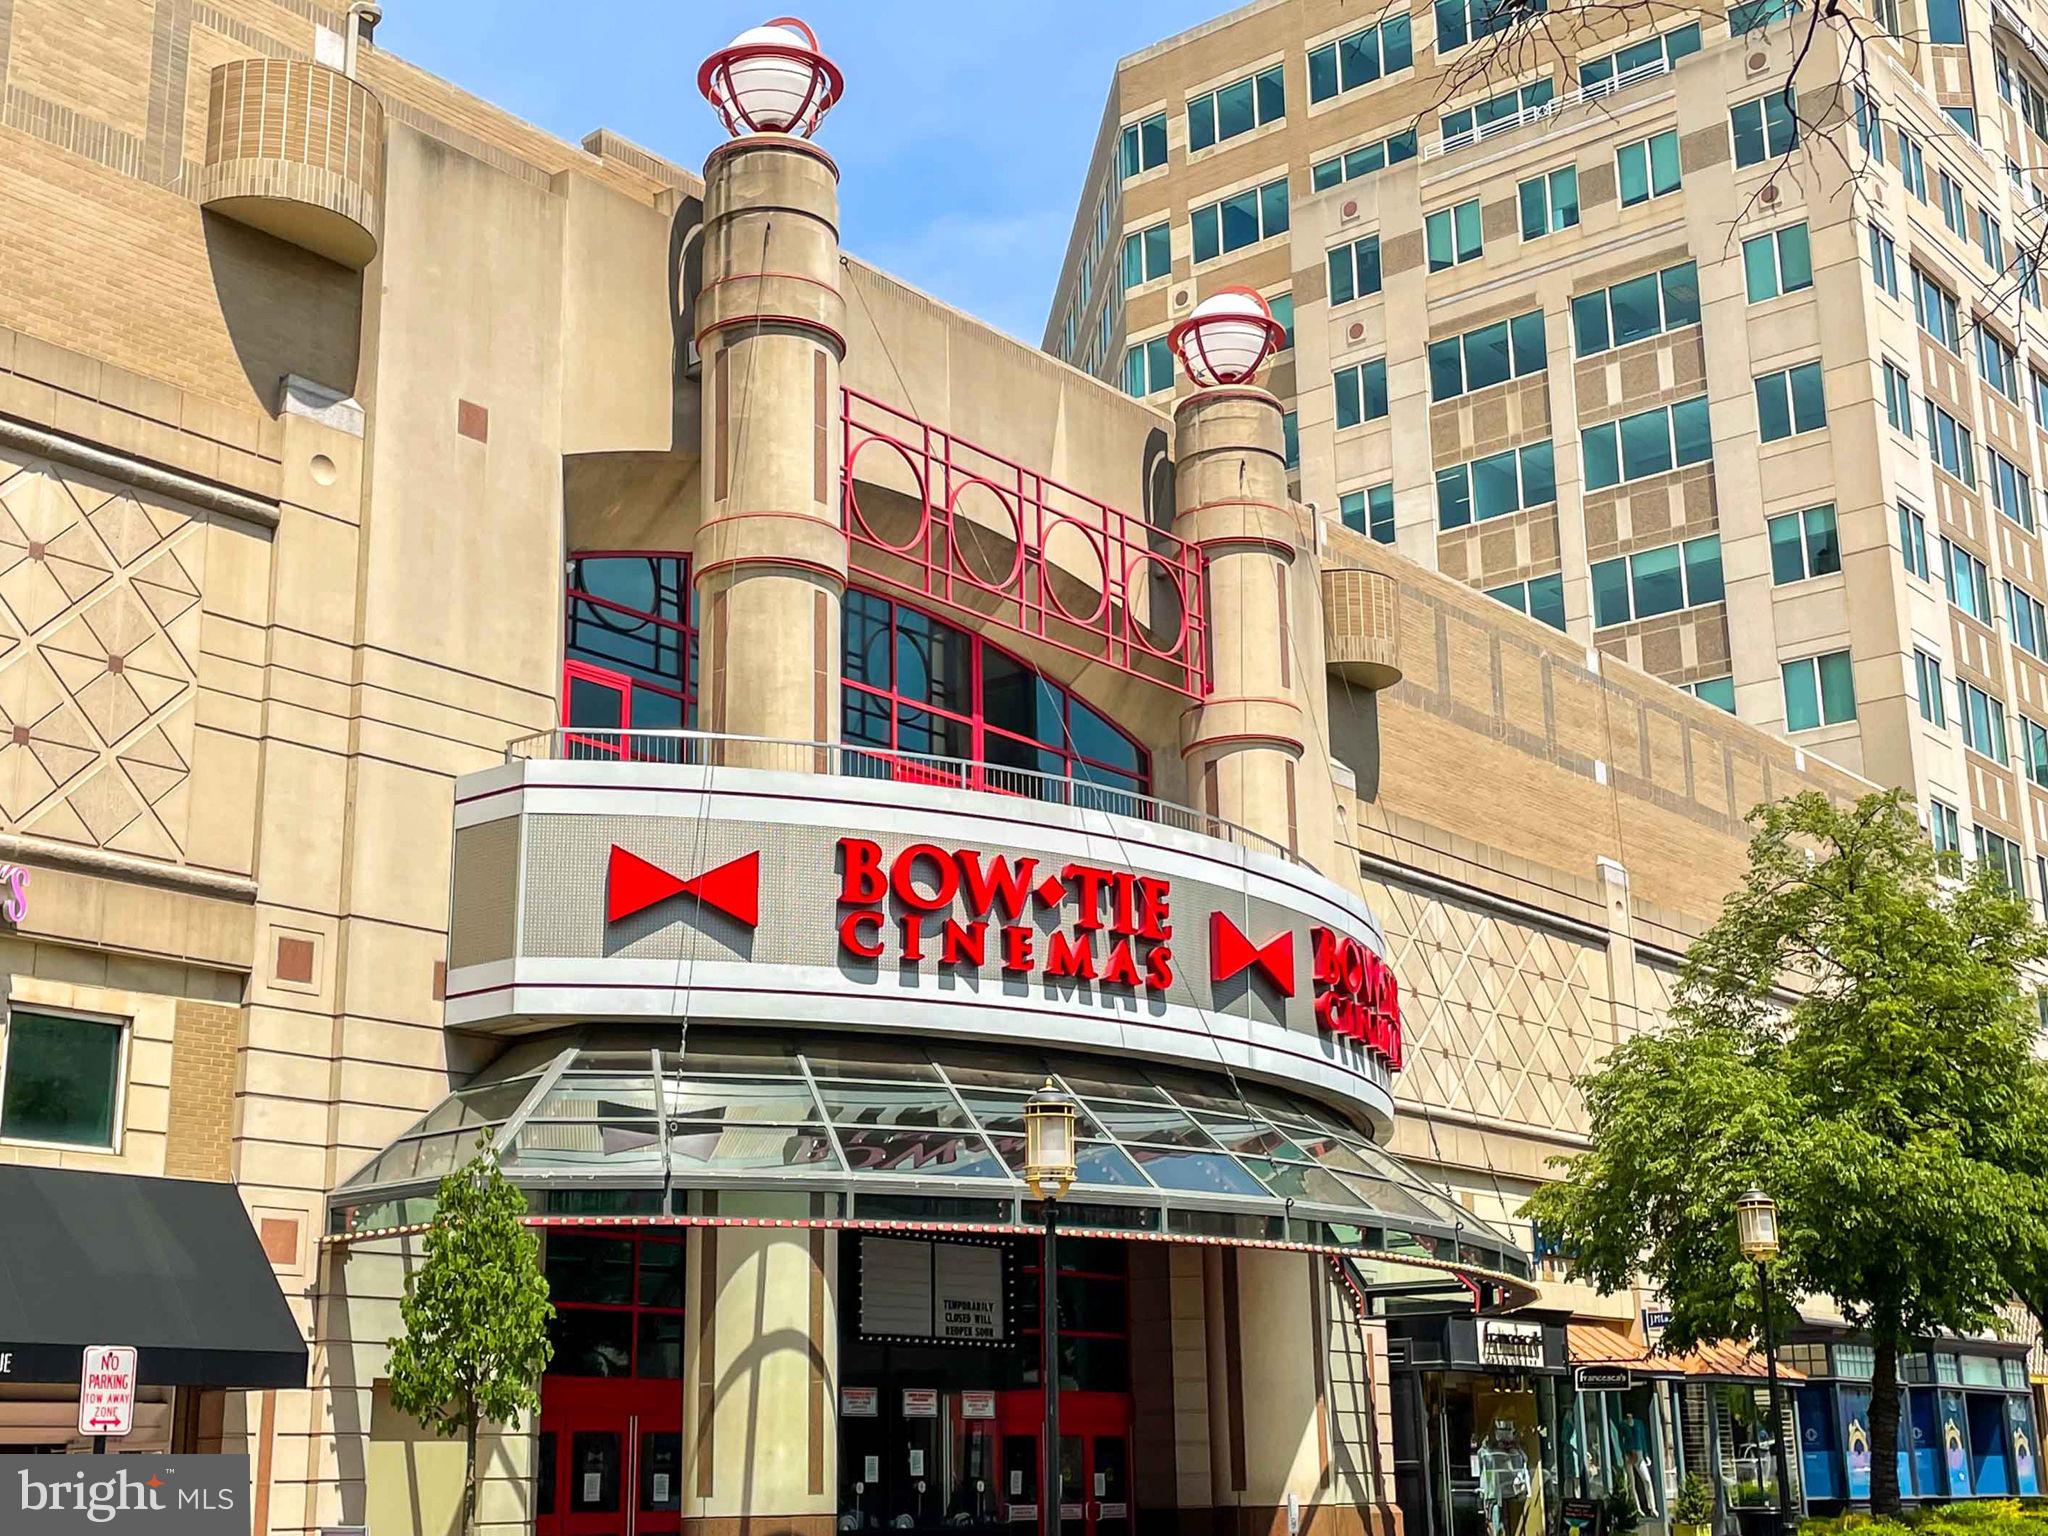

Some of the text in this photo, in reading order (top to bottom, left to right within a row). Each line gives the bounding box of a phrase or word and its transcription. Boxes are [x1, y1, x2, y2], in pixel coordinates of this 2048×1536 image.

[837, 837, 1173, 941] BOW TIE
[839, 909, 1173, 990] CINEMAS
[943, 1300, 994, 1312] TEMPORARILY
[945, 1312, 992, 1325] CLOSED WILL
[945, 1326, 994, 1338] REOPEN SOON
[101, 1355, 120, 1370] NO
[88, 1374, 128, 1389] PARKING
[86, 1394, 130, 1404] TOW AWAY
[94, 1406, 118, 1418] ZONE
